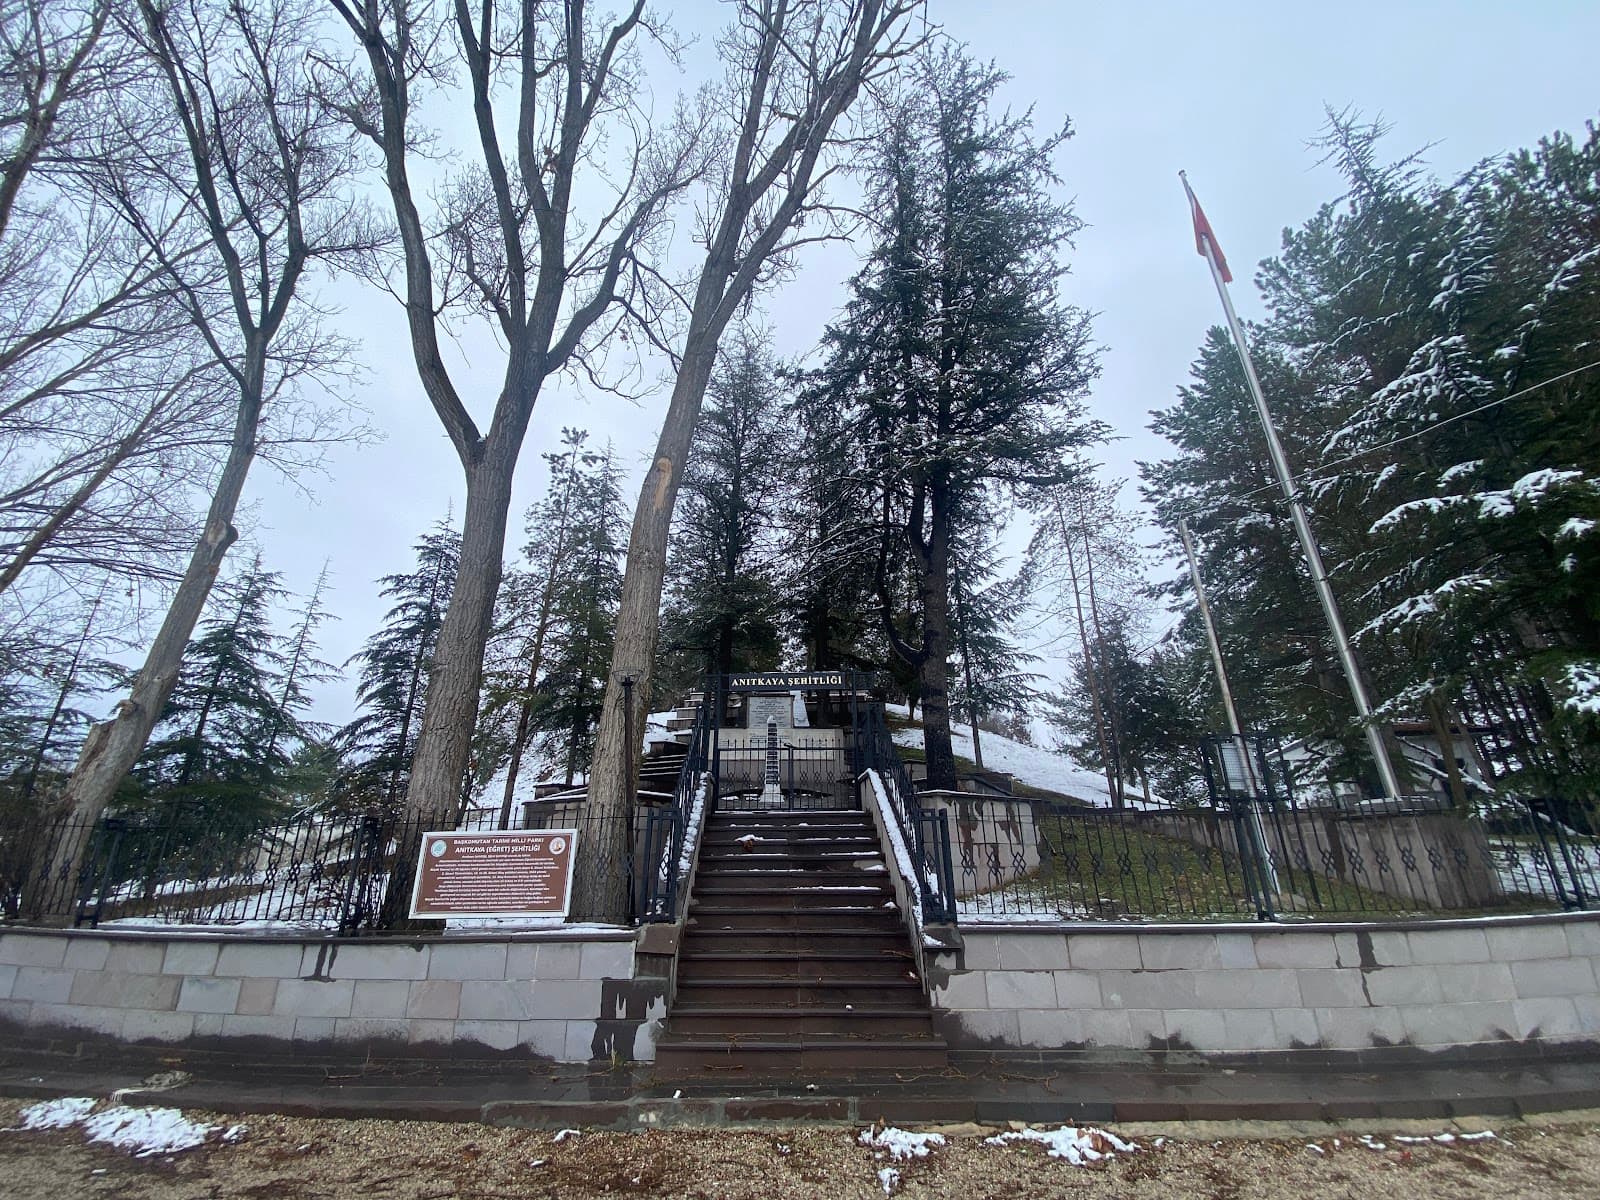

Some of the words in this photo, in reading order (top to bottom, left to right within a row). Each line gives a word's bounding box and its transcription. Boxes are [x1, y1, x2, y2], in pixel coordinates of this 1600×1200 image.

[731, 678, 785, 687] ANITKAYA
[787, 676, 842, 687] ŞEHİTLİĞİ
[486, 845, 510, 853] (EĞRET)
[511, 844, 540, 853] ŞEHİTLİĞİ
